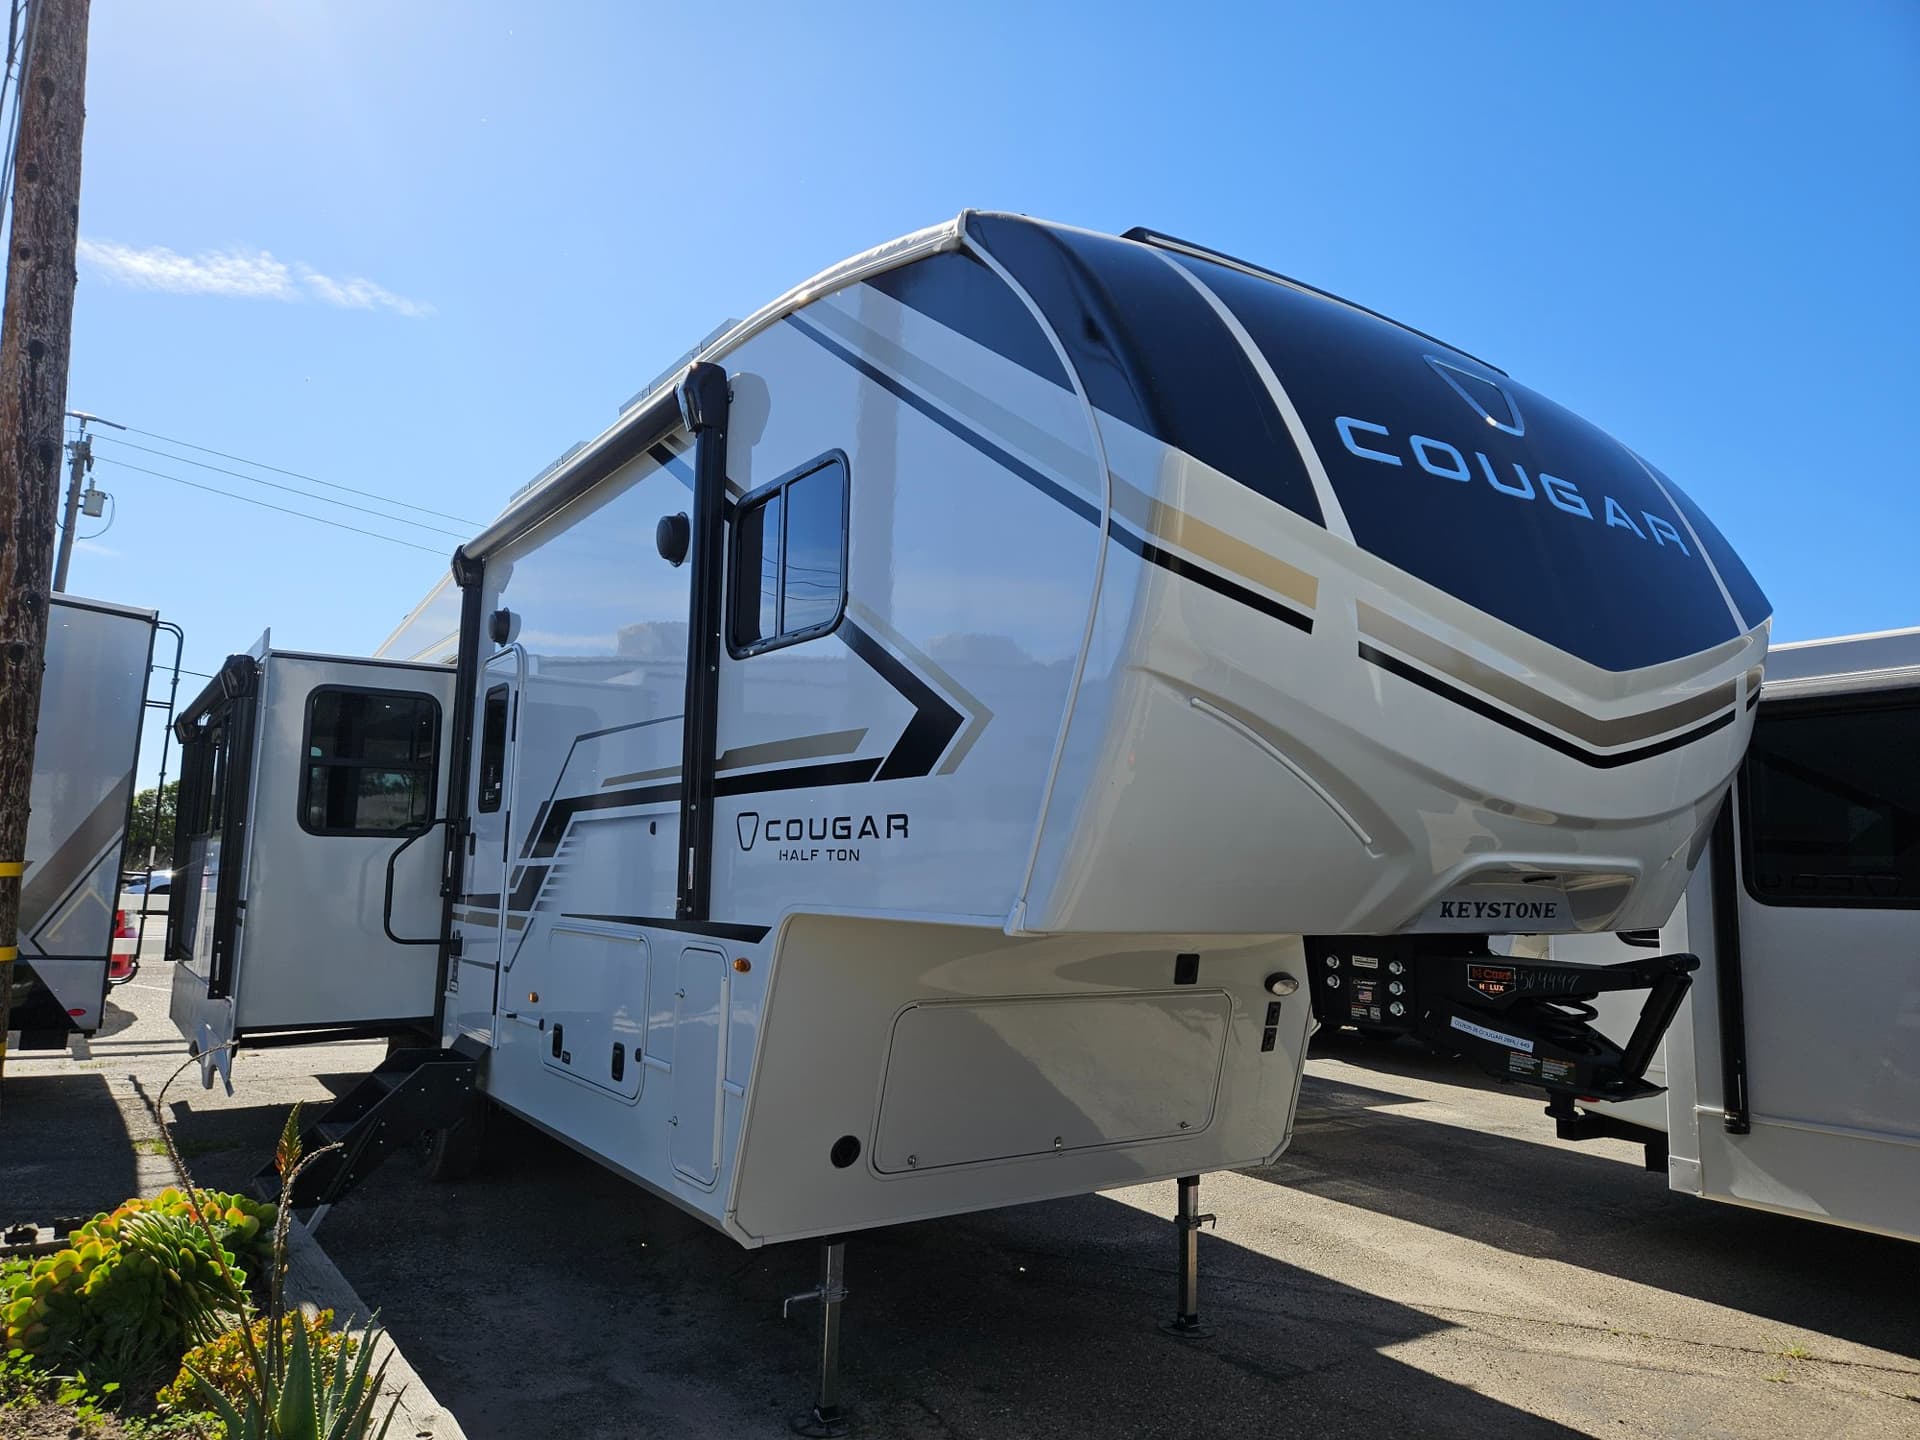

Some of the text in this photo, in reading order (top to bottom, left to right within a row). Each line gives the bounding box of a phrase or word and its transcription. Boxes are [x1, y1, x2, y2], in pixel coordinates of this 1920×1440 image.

[1334, 416, 1691, 557] COUGAR
[765, 814, 909, 841] COUGAR
[779, 849, 860, 861] HALF TON
[1439, 901, 1558, 919] KEYSTONE
